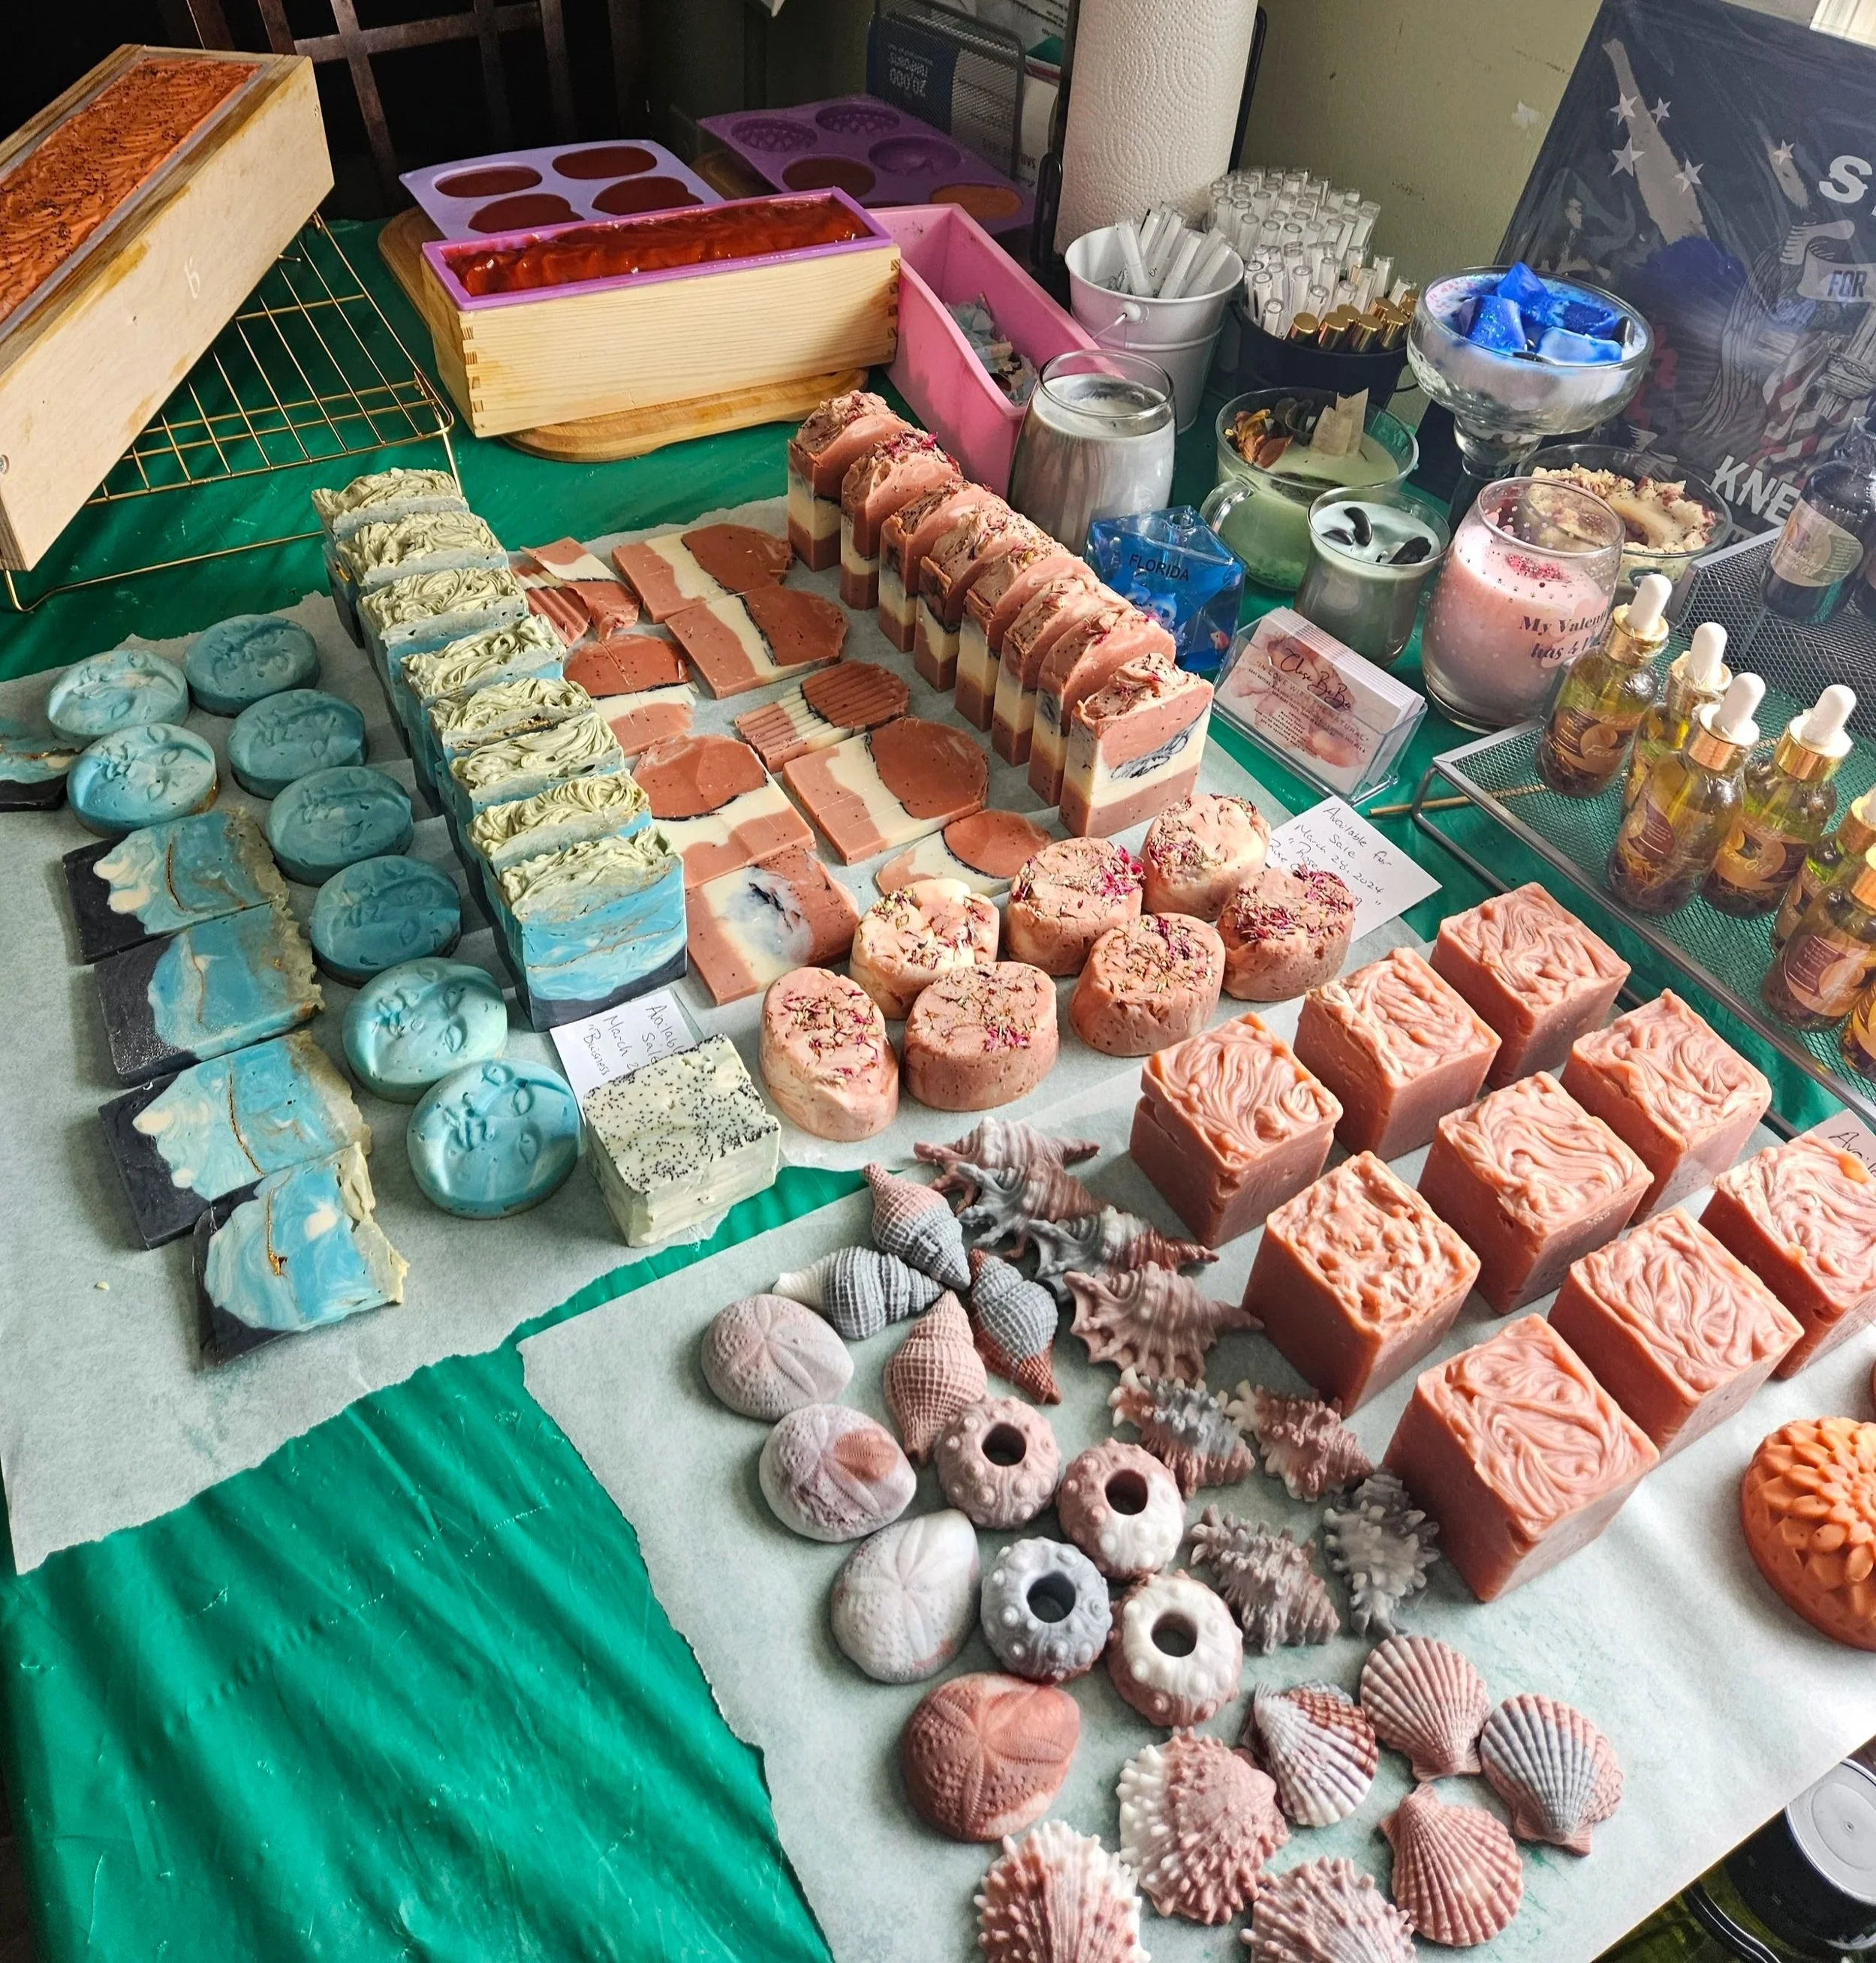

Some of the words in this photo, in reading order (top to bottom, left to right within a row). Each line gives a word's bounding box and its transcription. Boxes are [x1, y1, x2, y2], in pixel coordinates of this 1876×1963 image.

[1819, 155, 1876, 216] S
[1827, 270, 1868, 297] FOR
[1710, 455, 1802, 526] KNE
[1128, 553, 1189, 583] FLORIDA
[1519, 616, 1552, 635] My
[1530, 643, 1564, 660] has
[1567, 640, 1579, 655] 4
[1267, 669, 1287, 686] LOVE
[1289, 685, 1310, 700] WITH
[1323, 807, 1367, 848] Available
[1373, 851, 1393, 866] for
[1329, 834, 1356, 860] Sale
[1293, 824, 1326, 854] March
[1353, 872, 1386, 894] 2024
[603, 1015, 633, 1057] March
[645, 1005, 685, 1052] Availabl
